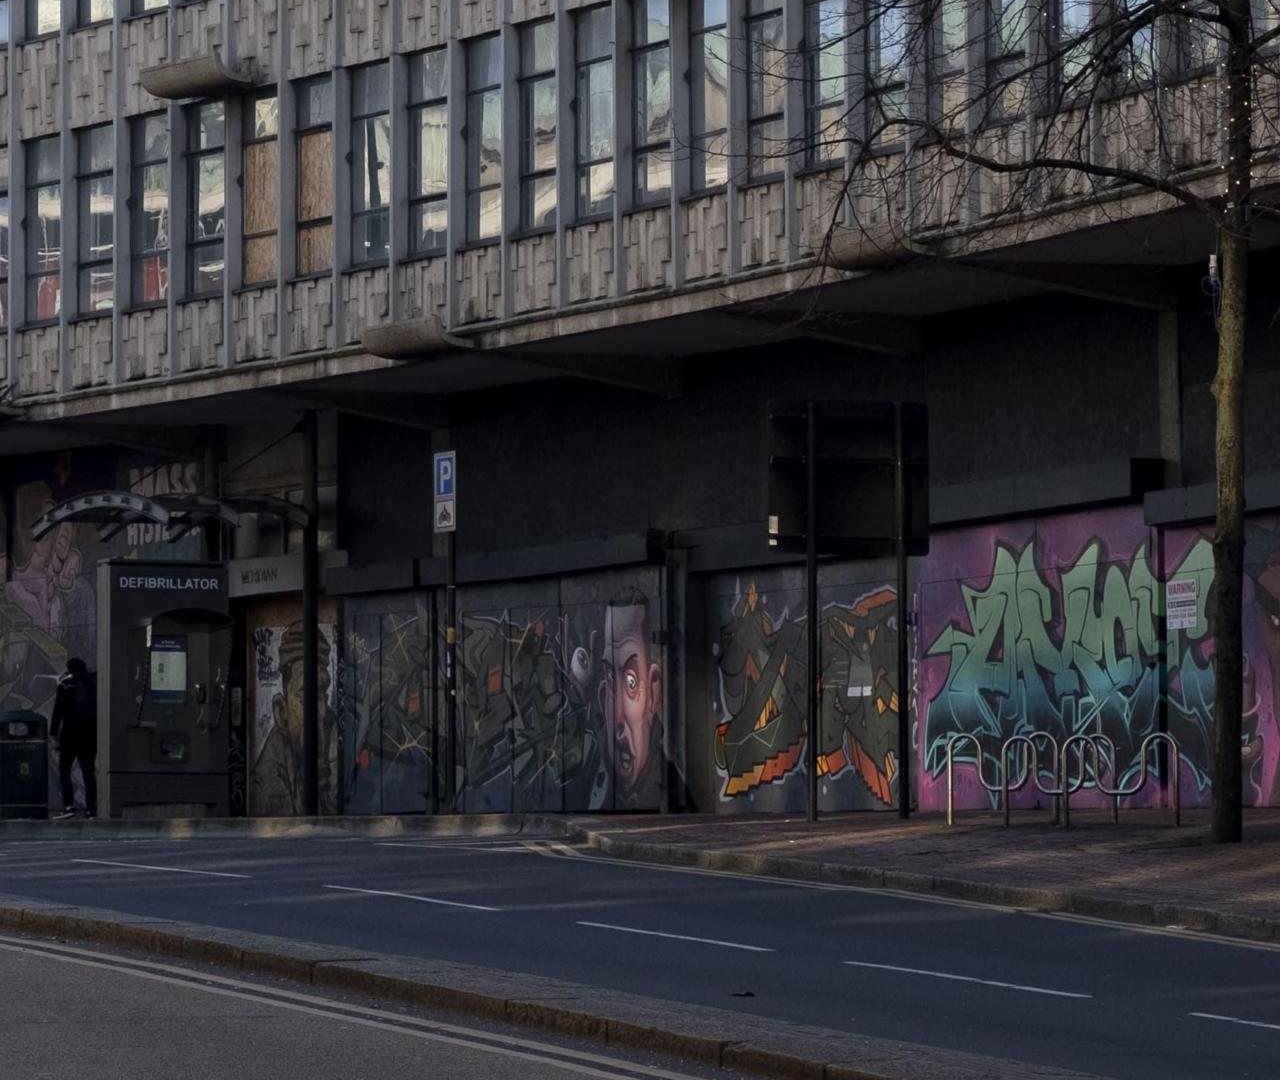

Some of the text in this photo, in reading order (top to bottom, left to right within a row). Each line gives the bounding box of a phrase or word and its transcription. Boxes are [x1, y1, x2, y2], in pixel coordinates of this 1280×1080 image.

[129, 461, 198, 497] MASS
[439, 459, 452, 494] P
[119, 576, 220, 590] DEFIBRILLATOR
[1168, 581, 1196, 595] WARNING
